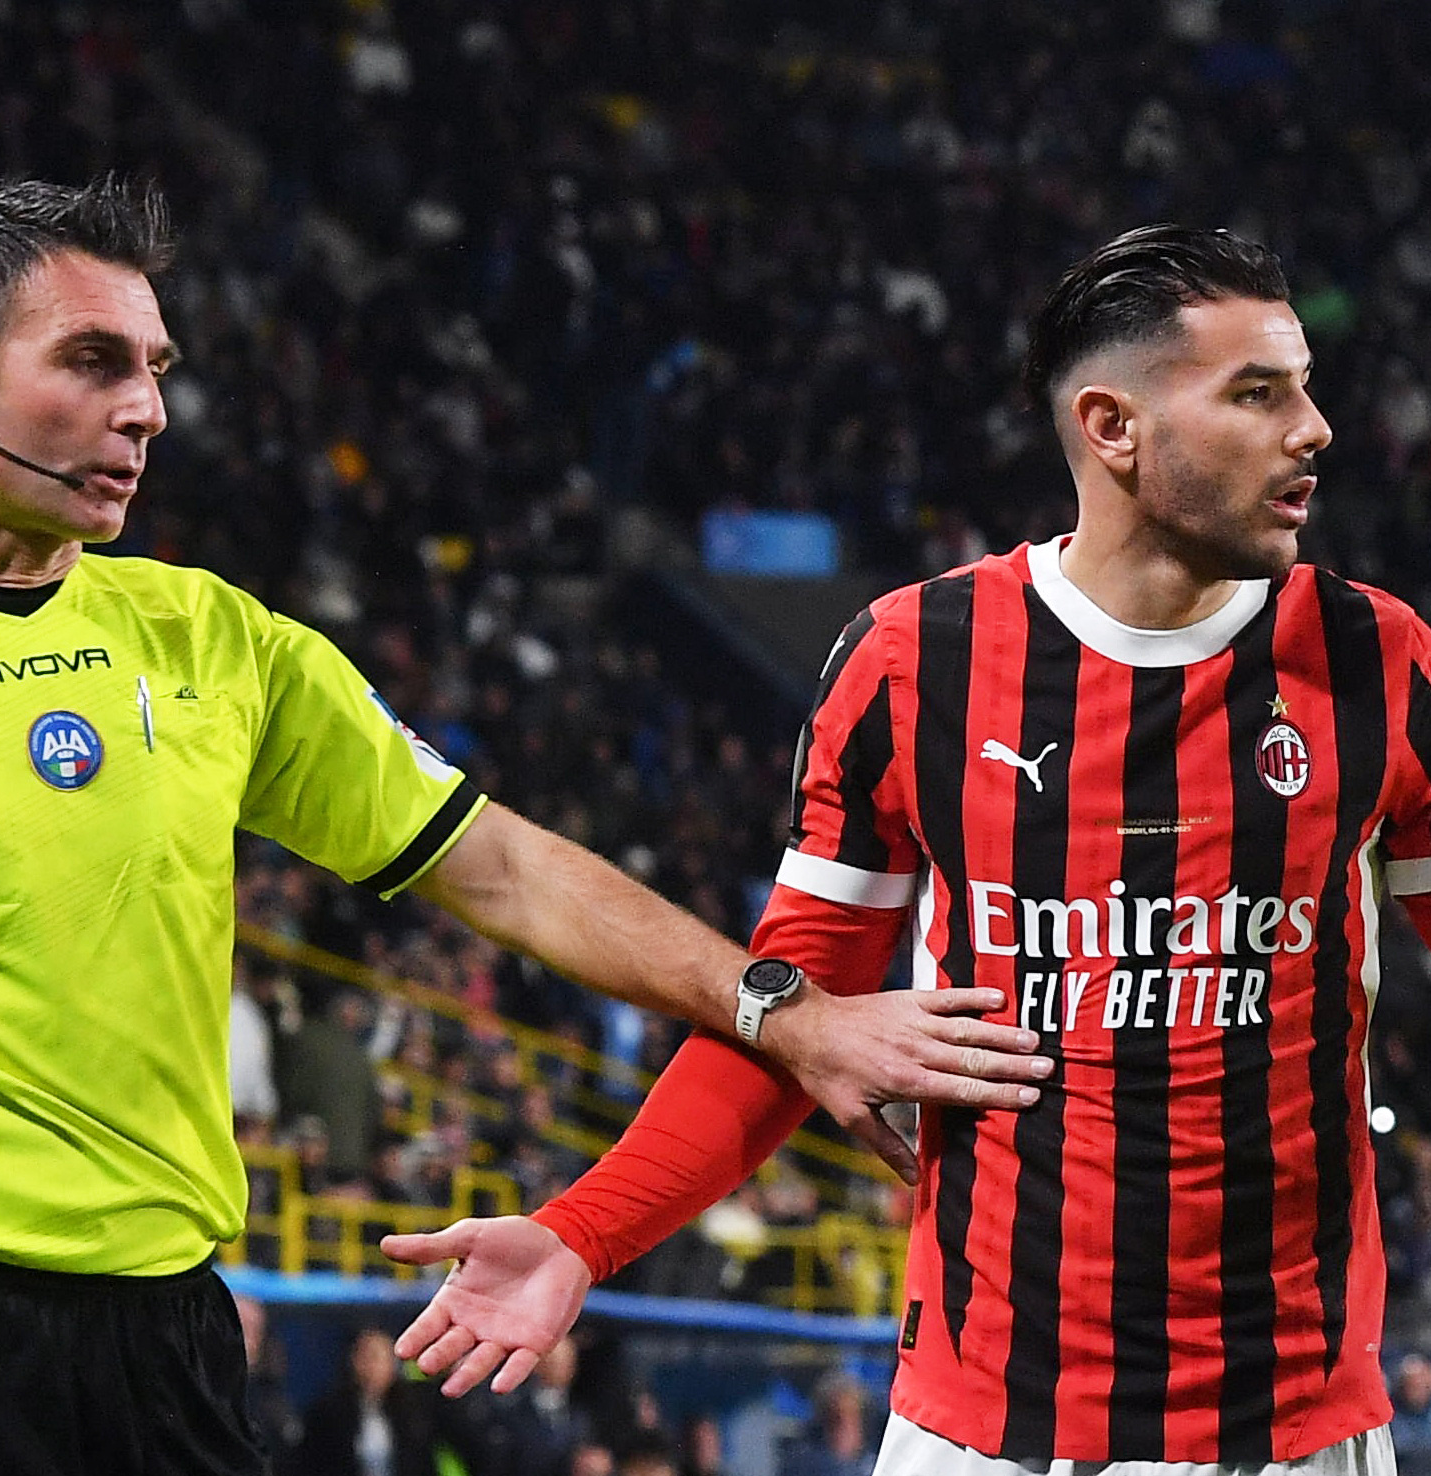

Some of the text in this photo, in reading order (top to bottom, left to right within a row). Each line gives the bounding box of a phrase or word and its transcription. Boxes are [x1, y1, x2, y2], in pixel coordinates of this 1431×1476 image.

[42, 729, 91, 761] AIA
[1268, 727, 1297, 742] ACM
[969, 879, 1316, 958] Emirates
[1020, 968, 1267, 1032] FLY BETTER
